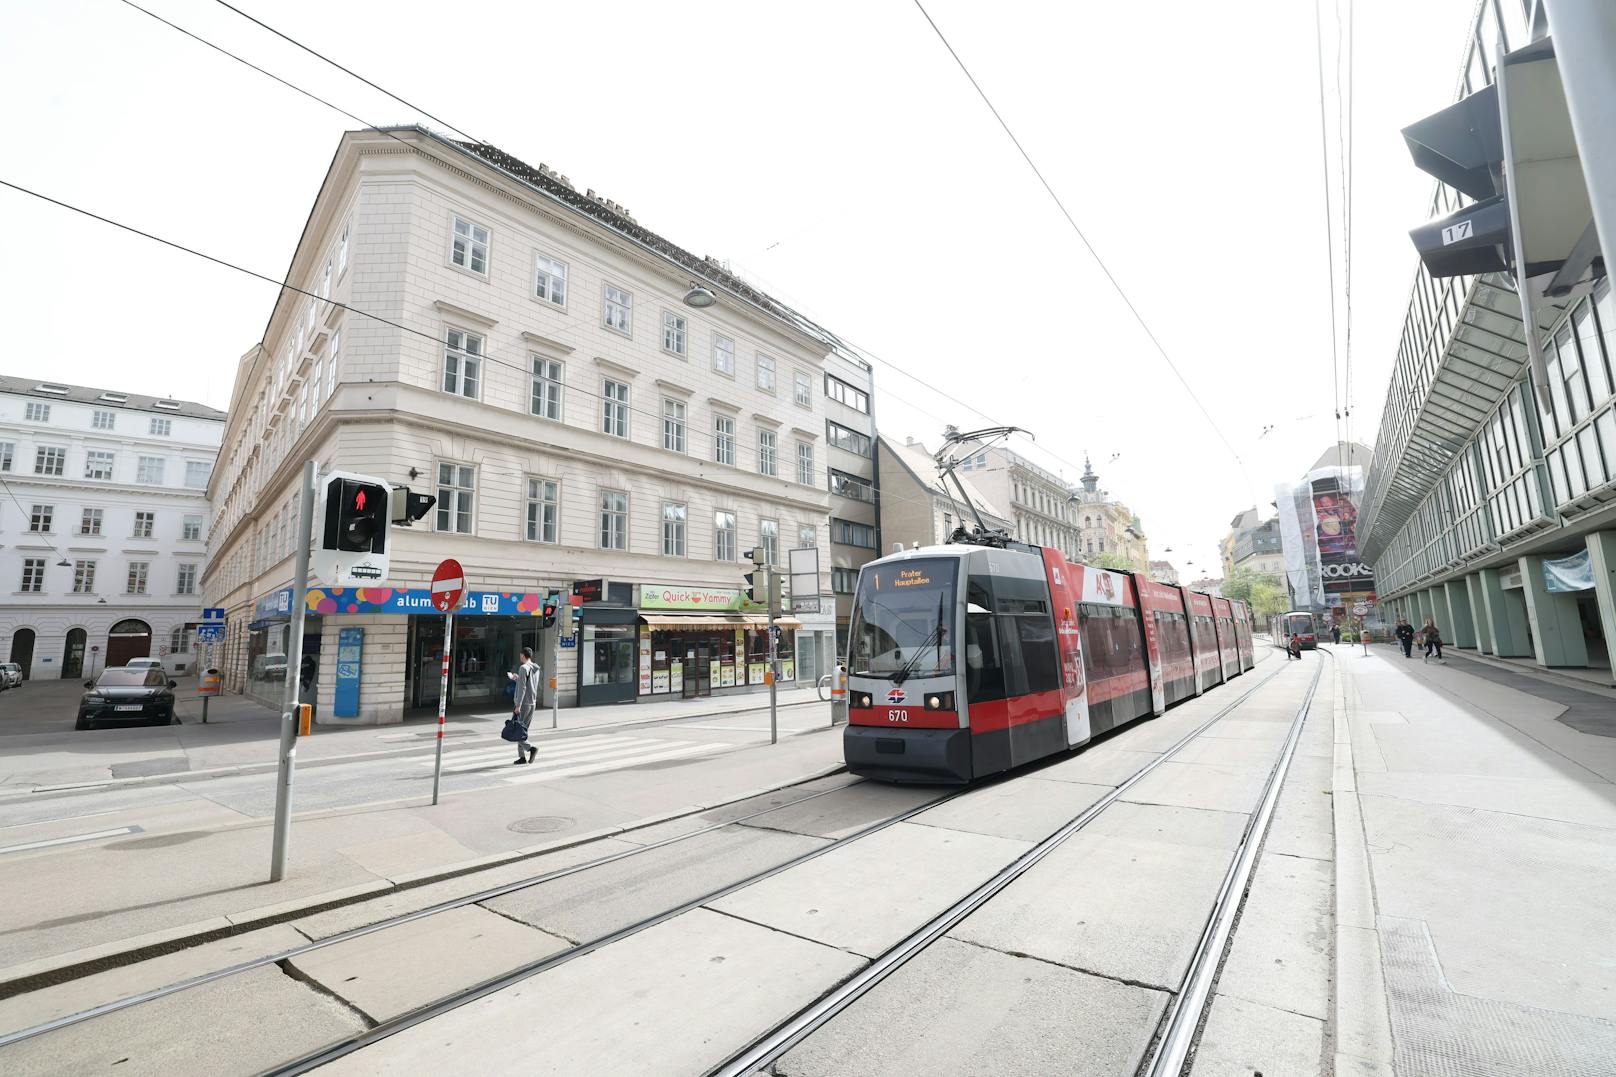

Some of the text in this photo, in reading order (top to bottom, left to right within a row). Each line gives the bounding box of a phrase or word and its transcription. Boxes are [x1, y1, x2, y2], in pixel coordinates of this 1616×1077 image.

[1446, 222, 1470, 242] 17
[901, 570, 921, 578] Prater
[874, 574, 879, 591] 1
[895, 578, 930, 587] Hauptallee
[397, 596, 434, 608] alum
[484, 596, 498, 605] TU
[662, 590, 690, 603] Quick
[888, 710, 908, 721] 670
